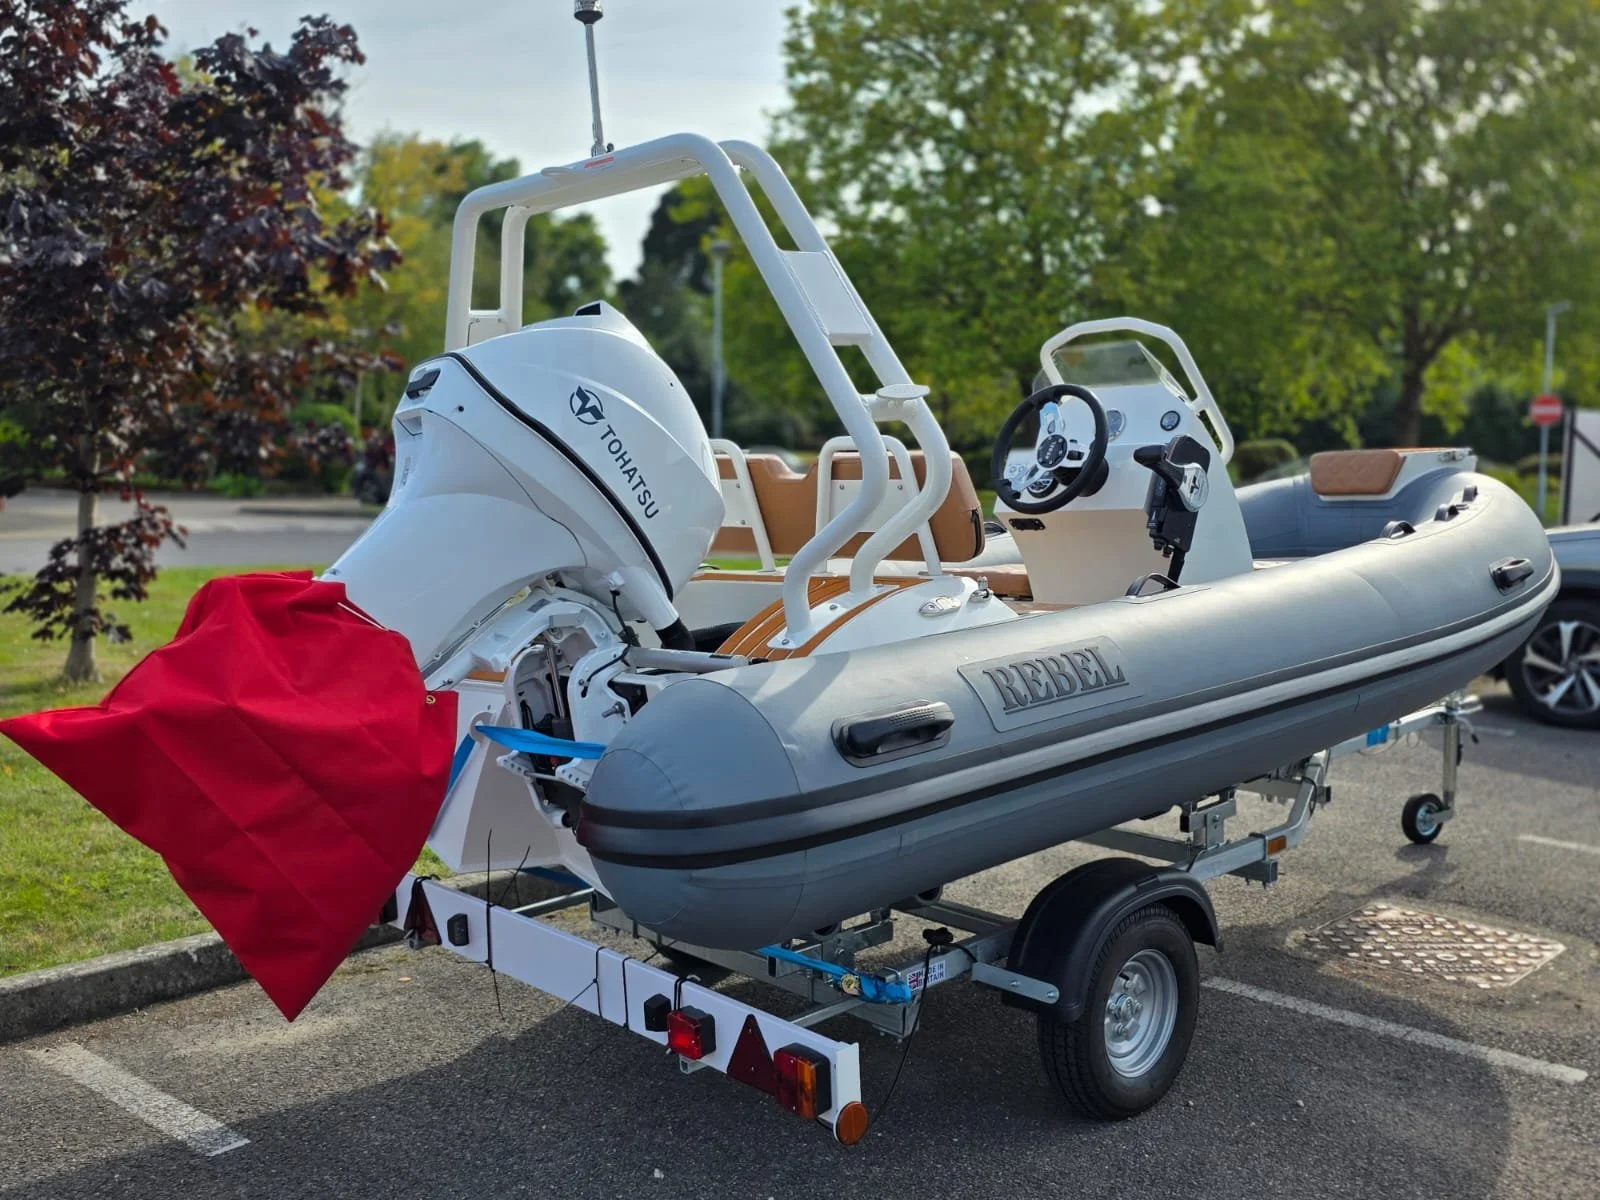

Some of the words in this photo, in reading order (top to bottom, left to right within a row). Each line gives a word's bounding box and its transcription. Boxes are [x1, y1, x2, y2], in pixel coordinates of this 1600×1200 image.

[600, 424, 660, 519] TOHATSU
[982, 646, 1126, 711] REBEL
[918, 965, 937, 978] MDE
[918, 971, 944, 986] BITAIN
